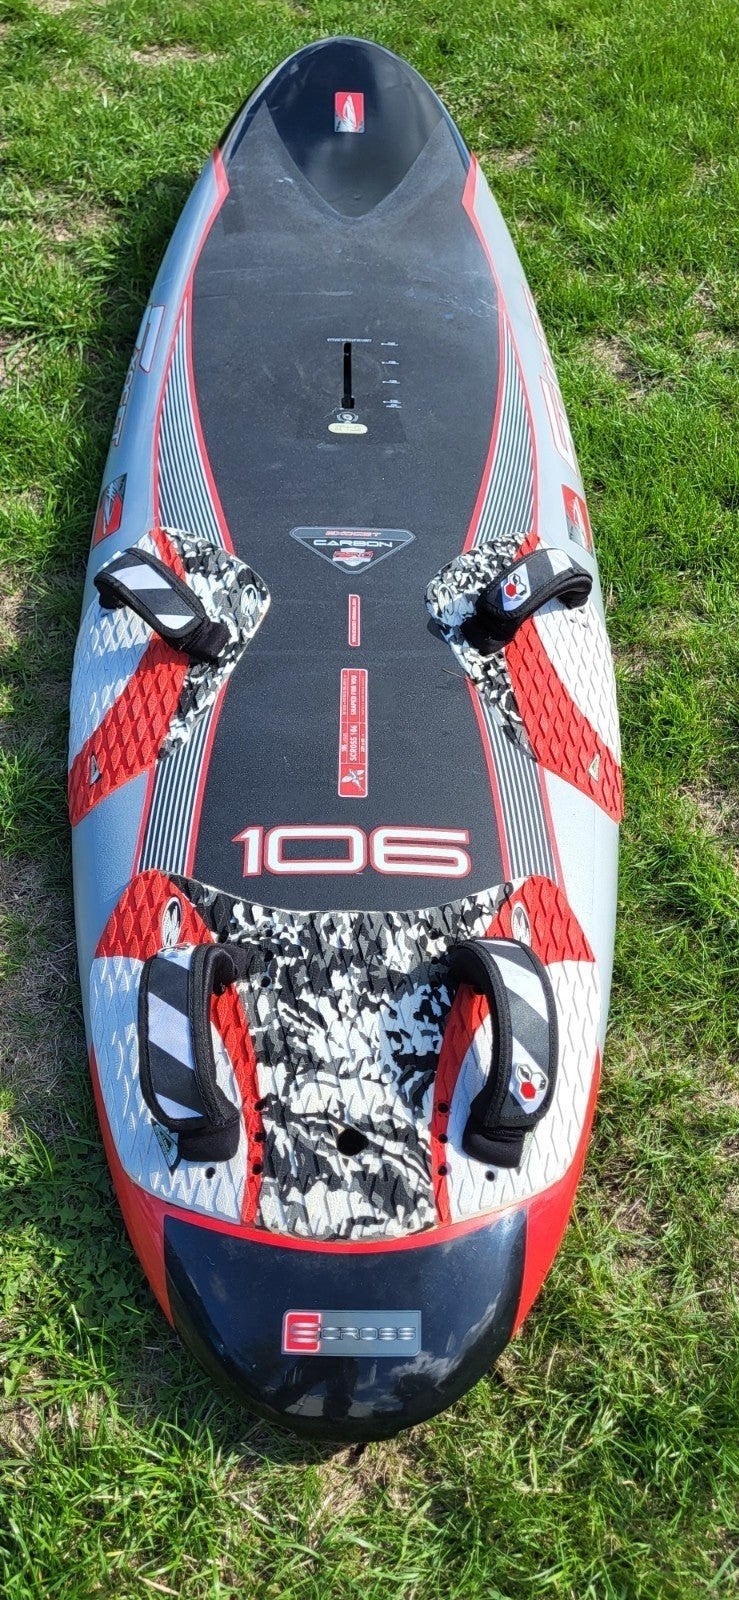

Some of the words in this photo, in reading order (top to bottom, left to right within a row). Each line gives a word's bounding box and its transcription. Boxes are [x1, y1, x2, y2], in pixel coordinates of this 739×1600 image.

[313, 539, 393, 547] CARBON
[349, 737, 358, 762] SCROSS
[231, 824, 472, 879] 106
